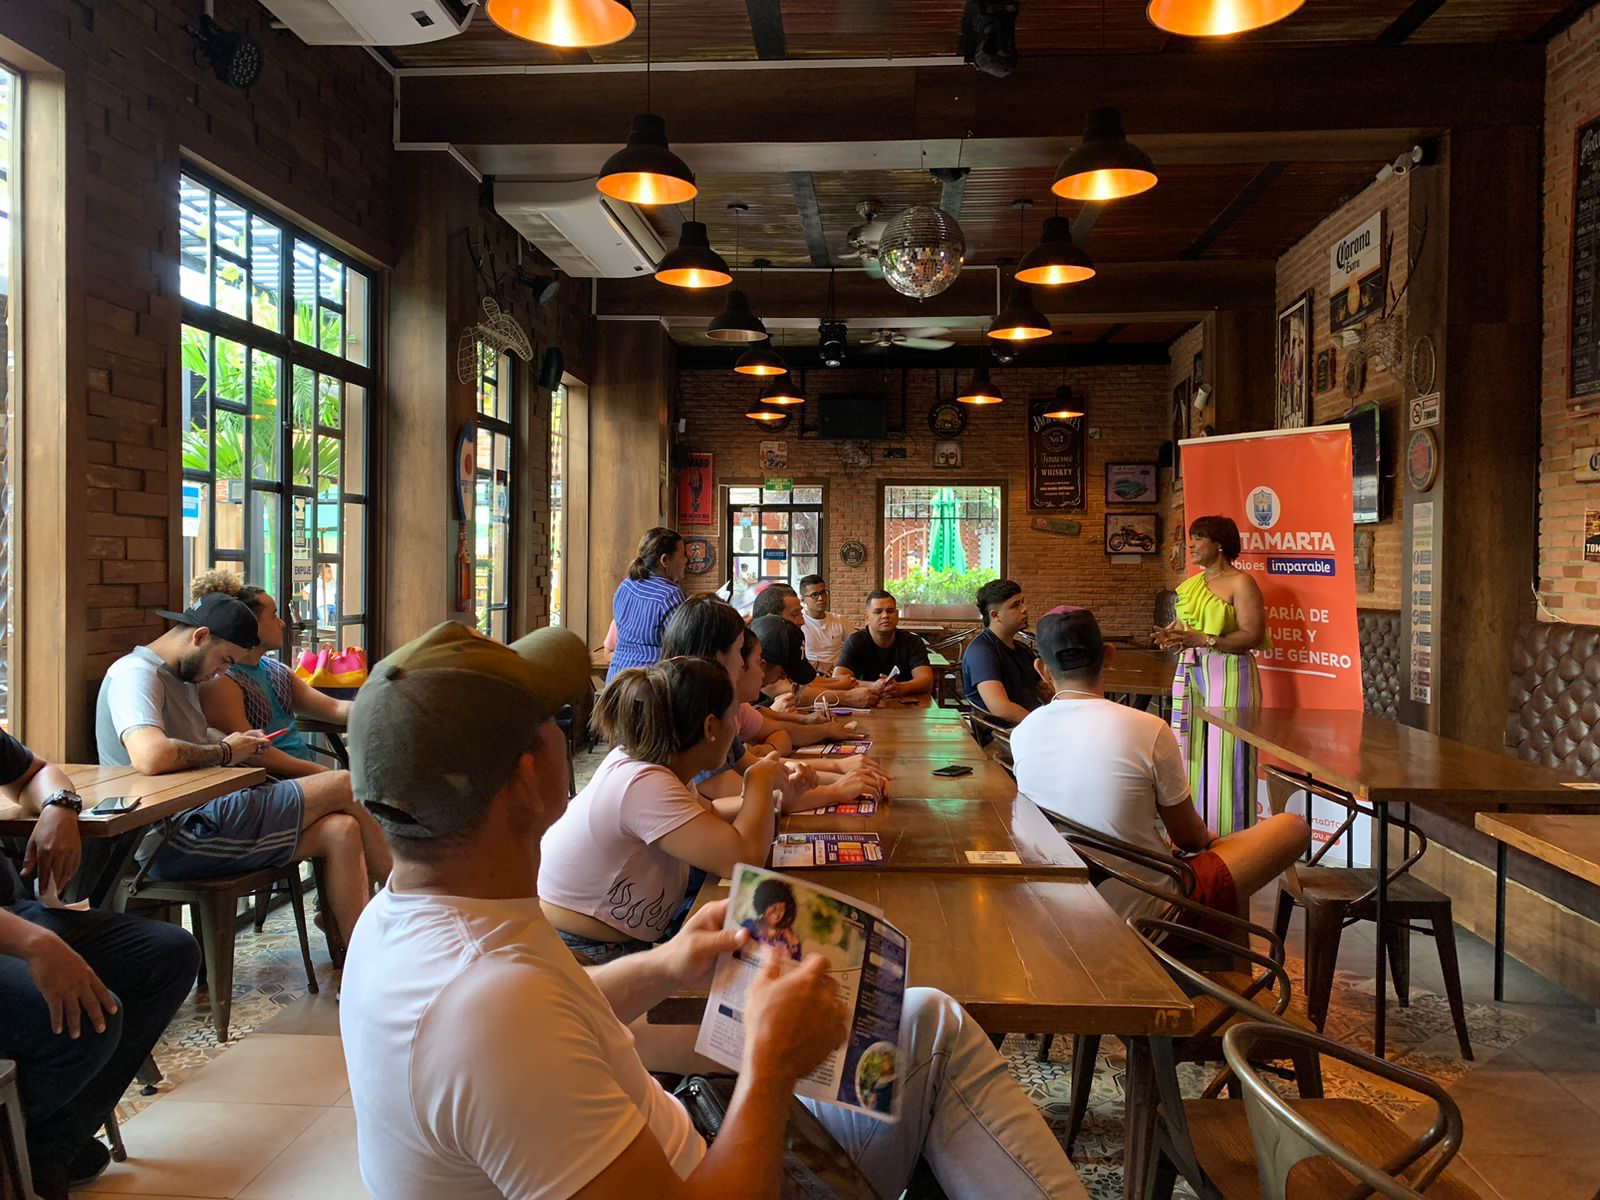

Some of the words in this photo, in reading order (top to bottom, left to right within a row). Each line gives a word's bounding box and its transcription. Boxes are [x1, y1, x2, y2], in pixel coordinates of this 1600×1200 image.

[1336, 229, 1370, 270] Corona
[1240, 531, 1335, 551] TAMARTA
[1231, 559, 1252, 570] bio
[1254, 562, 1265, 571] es
[1271, 560, 1331, 574] imparable
[1309, 608, 1329, 623] DE
[1306, 630, 1317, 643] Y
[1263, 647, 1284, 660] DE
[1287, 647, 1352, 669] GÉNERO
